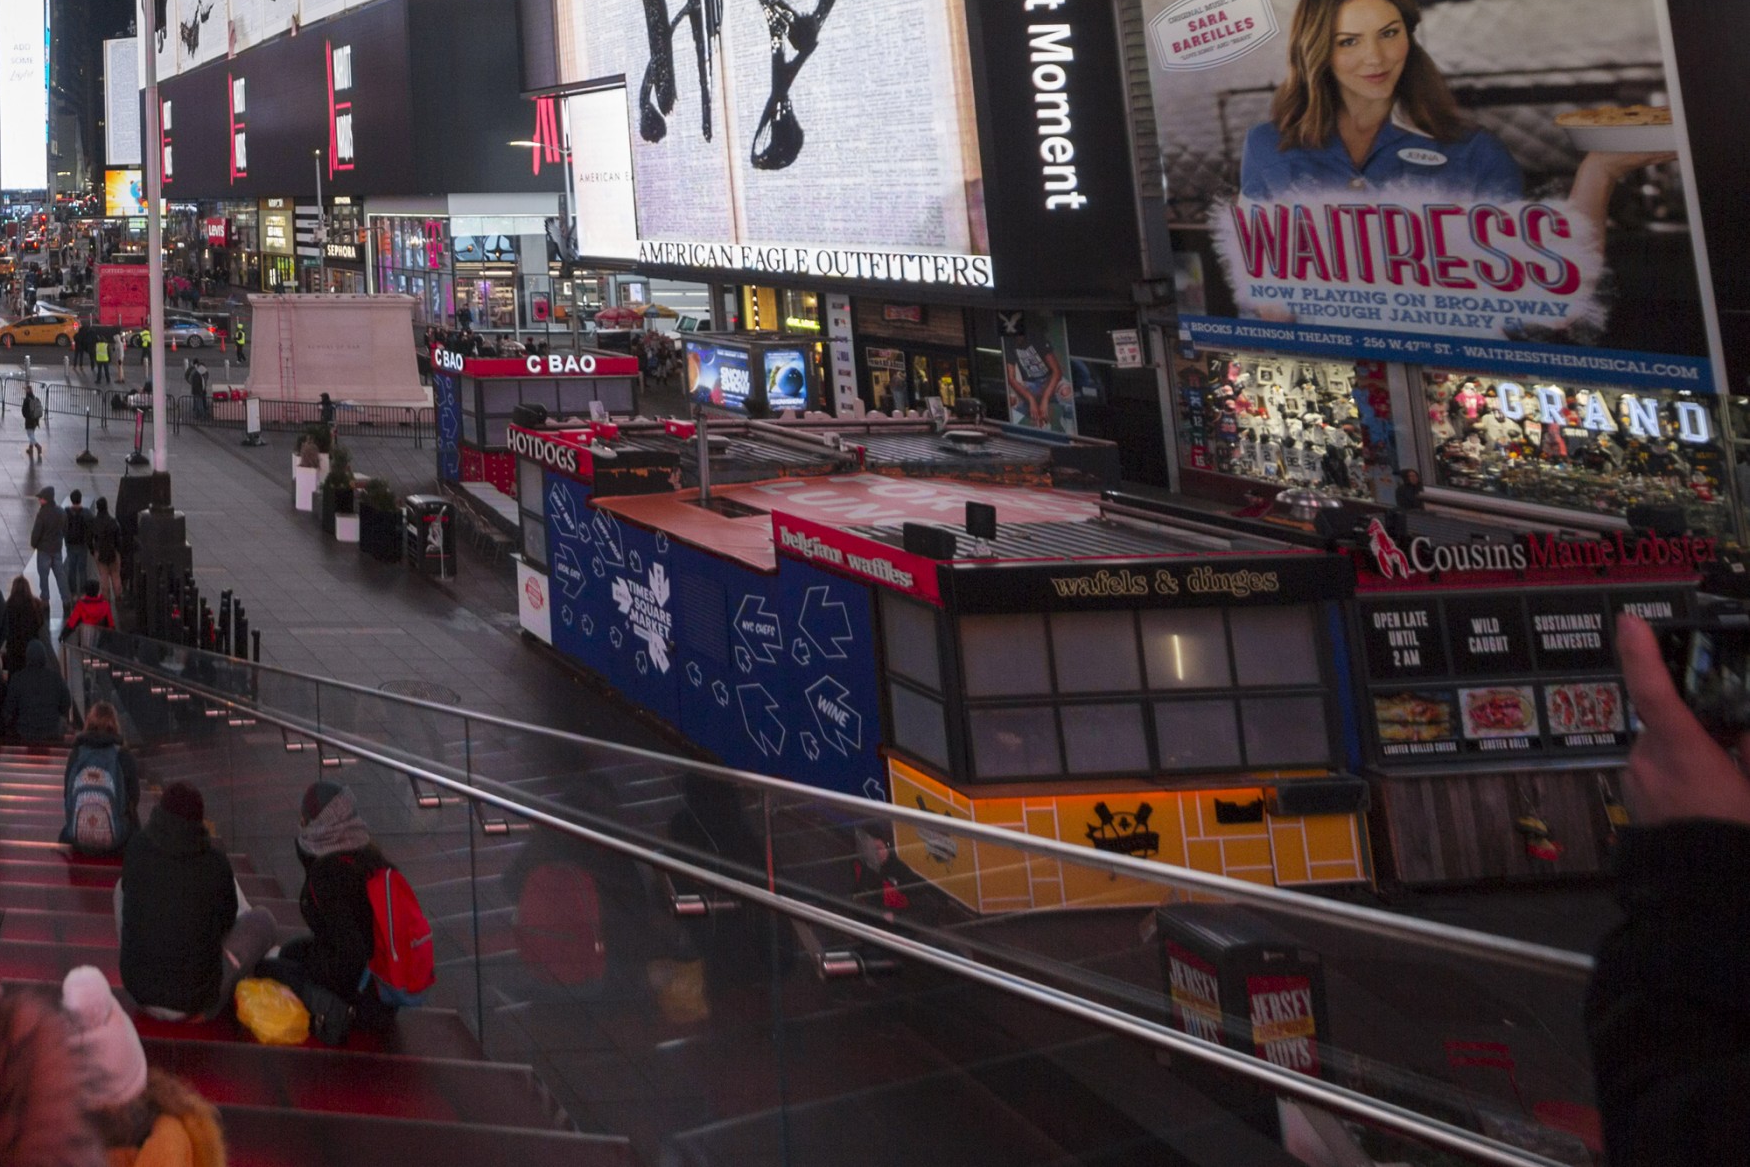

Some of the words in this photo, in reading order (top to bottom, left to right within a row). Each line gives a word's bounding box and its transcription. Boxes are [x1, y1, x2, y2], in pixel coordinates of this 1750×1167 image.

[1172, 16, 1255, 54] BAREILLES
[1187, 10, 1229, 33] SARA
[1027, 23, 1088, 212] Moment
[1403, 151, 1442, 165] JENNA
[579, 172, 621, 183] AMERICAN
[326, 244, 357, 259] SEPHORA
[638, 241, 737, 270] AMERICAN
[740, 245, 810, 275] EAGLE
[815, 249, 991, 287] OUTFITTERS
[1230, 202, 1581, 295] WAITRESS
[1250, 284, 1295, 301] NOW
[1302, 287, 1388, 309] PLAYING
[1393, 293, 1425, 309] ON
[1433, 294, 1569, 318] BROADWAY
[1287, 300, 1384, 323] THROUGH
[1389, 306, 1498, 331] JANUARY
[434, 348, 443, 367] C
[443, 350, 465, 372] BAO
[526, 353, 543, 373] C
[548, 353, 597, 374] BAO
[1190, 321, 1233, 335] BROOKS
[1234, 326, 1296, 341] ATKINSON
[1297, 330, 1353, 347] THEATRE
[1362, 336, 1387, 349] 256
[1462, 345, 1699, 382] WAITRESSTHEMUSICAL.COM
[1497, 382, 1712, 445] GRAND
[506, 428, 578, 473] HOTDOGS
[778, 525, 845, 564] belgian
[1410, 535, 1528, 574] Cousins
[1528, 531, 1616, 569] Maine
[1616, 527, 1720, 566] Lobster
[626, 578, 657, 604] TIMES
[1051, 568, 1149, 598] wafels
[1154, 569, 1180, 593] &
[1185, 566, 1280, 600] dinges
[629, 608, 672, 640] MARKET
[633, 596, 674, 627] SQUARE
[1372, 611, 1401, 629] OPEN
[1401, 610, 1429, 628] LATE
[1470, 616, 1500, 634] WILD
[1533, 614, 1603, 632] SUSTAINABLY
[1623, 602, 1673, 619] PREMIUM
[741, 619, 758, 634] NYC
[757, 621, 777, 637] CHEFS
[1388, 629, 1420, 648] UNTIL
[1542, 632, 1602, 650] HARVESTED
[1393, 650, 1402, 667] 2
[1403, 648, 1421, 667] AM
[1468, 635, 1509, 654] CAUGHT
[817, 693, 850, 728] WINE
[1168, 954, 1219, 1004] JERSEY
[1250, 987, 1312, 1026] JERSEY
[1264, 1037, 1312, 1070] BOYS
